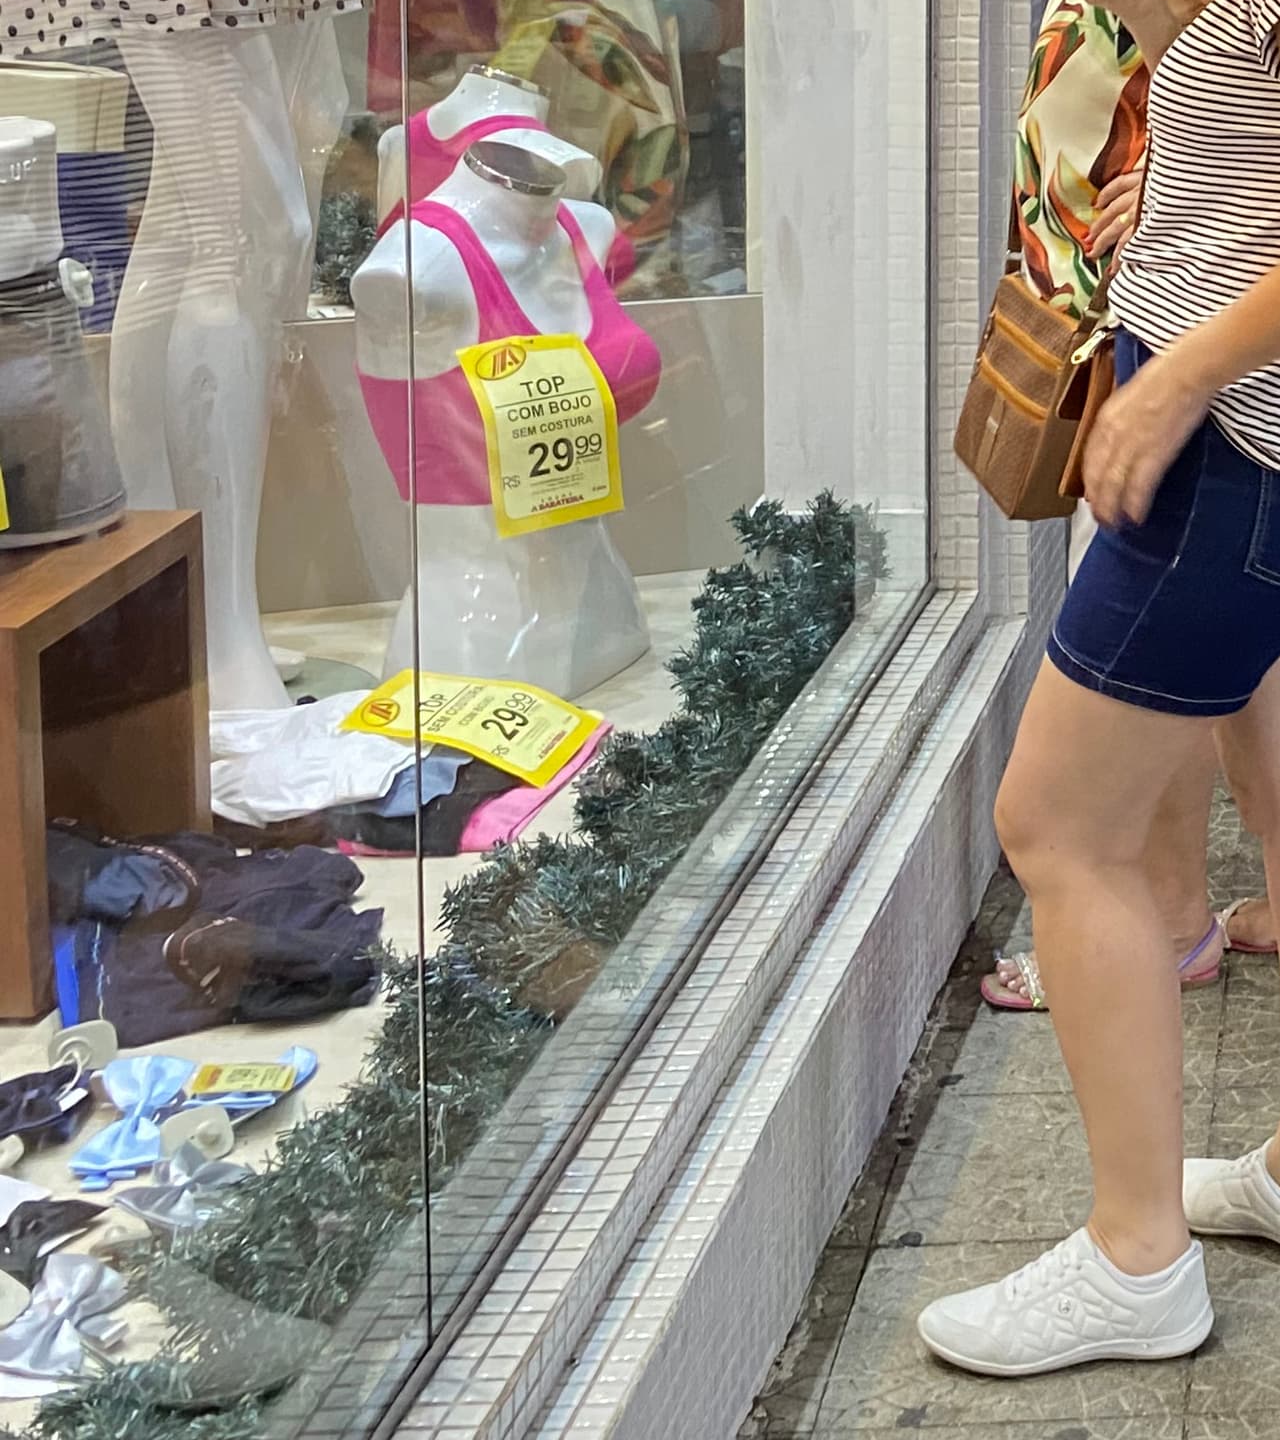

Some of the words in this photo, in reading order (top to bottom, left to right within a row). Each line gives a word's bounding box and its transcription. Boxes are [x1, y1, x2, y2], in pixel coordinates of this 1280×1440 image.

[519, 375, 565, 398] TOP
[507, 401, 545, 422] COM
[549, 395, 592, 415] BOJO
[512, 423, 537, 439] SEM
[540, 415, 594, 433] COSTURA
